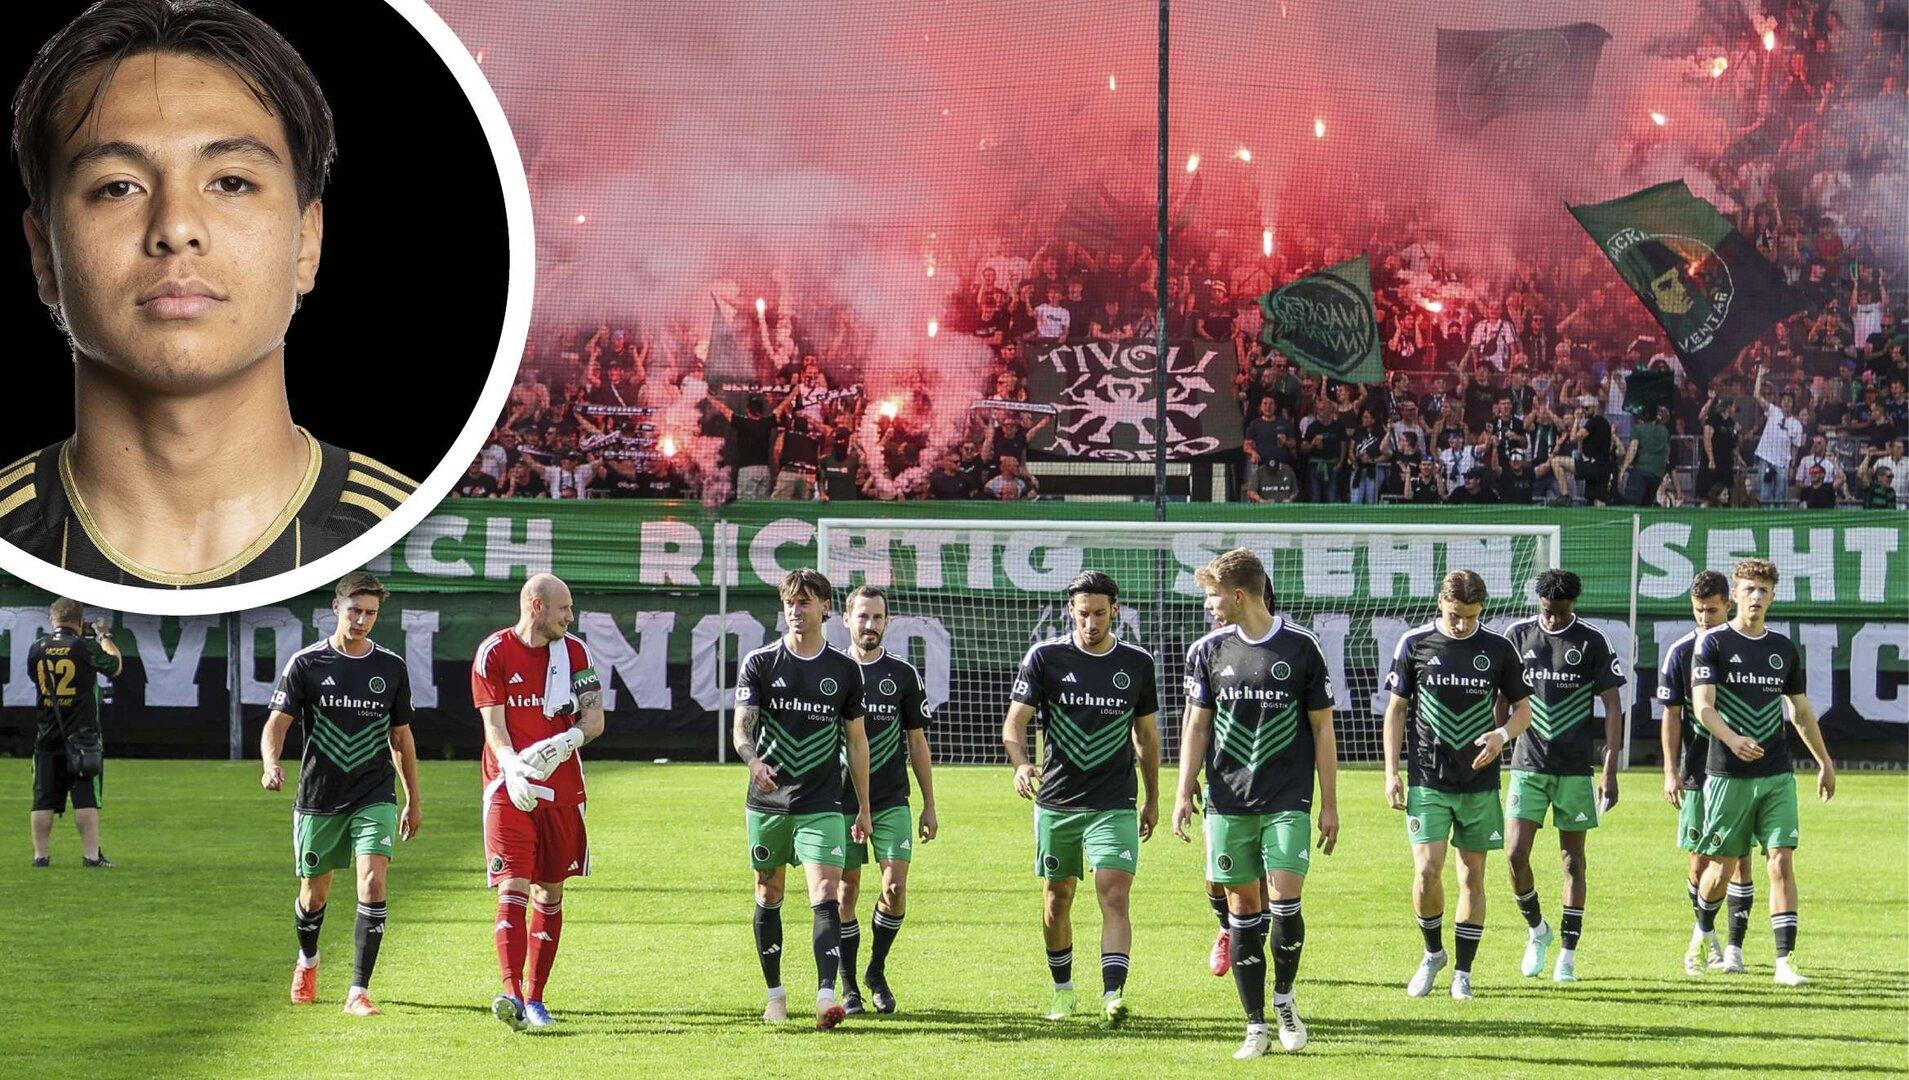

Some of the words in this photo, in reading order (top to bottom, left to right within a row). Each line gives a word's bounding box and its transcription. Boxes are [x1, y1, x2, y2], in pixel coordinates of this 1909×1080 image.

[1037, 342, 1219, 374] TIVOLI
[639, 518, 1083, 592] RICHTIG
[1638, 522, 1899, 603] SEHT
[0, 606, 439, 709] TVOI
